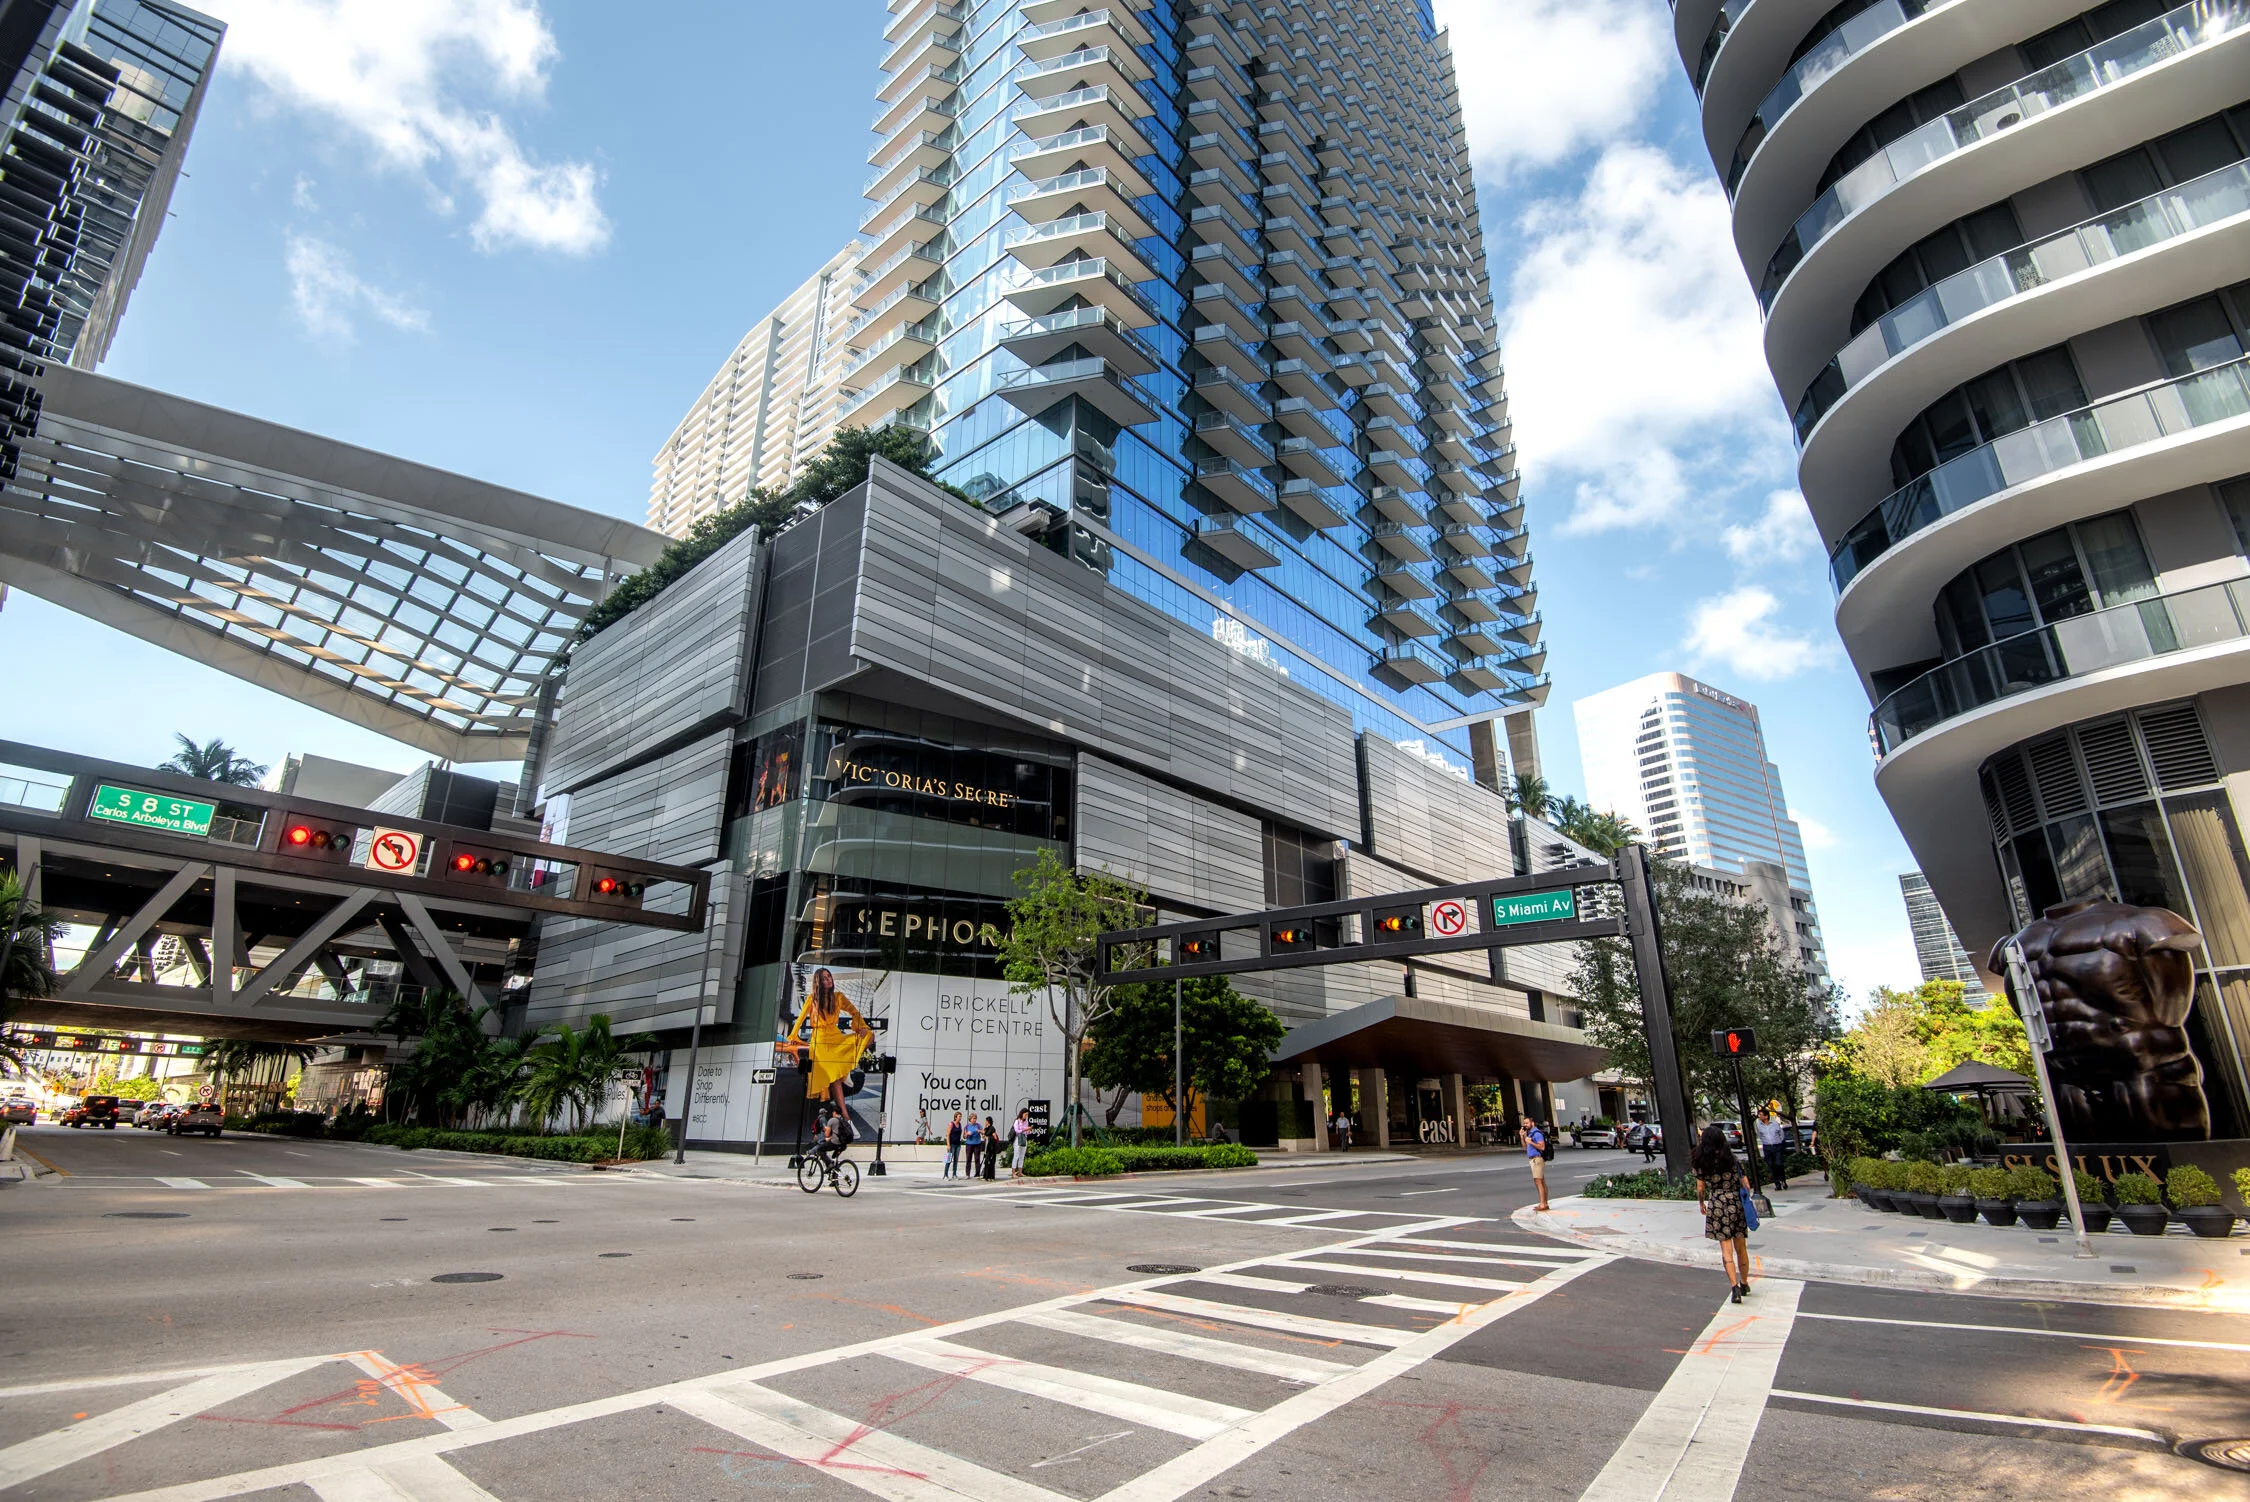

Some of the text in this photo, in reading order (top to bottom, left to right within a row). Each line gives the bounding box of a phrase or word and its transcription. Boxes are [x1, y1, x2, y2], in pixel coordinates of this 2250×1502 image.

[835, 759, 946, 796] VICORIA'S
[118, 794, 194, 818] S 8 ST
[95, 804, 207, 832] Carlos Arboleya Blvd
[1497, 899, 1570, 918] S Miami Av
[940, 994, 1029, 1015] BRICKELL
[920, 1015, 1043, 1037] CITY CENTRE
[697, 1066, 722, 1077] Dare to
[921, 1072, 987, 1090] You can
[696, 1079, 713, 1092] Shop
[694, 1091, 730, 1106] Differently.
[919, 1093, 1002, 1111] have it all.
[1029, 1104, 1048, 1113] east
[1419, 1115, 1456, 1144] east
